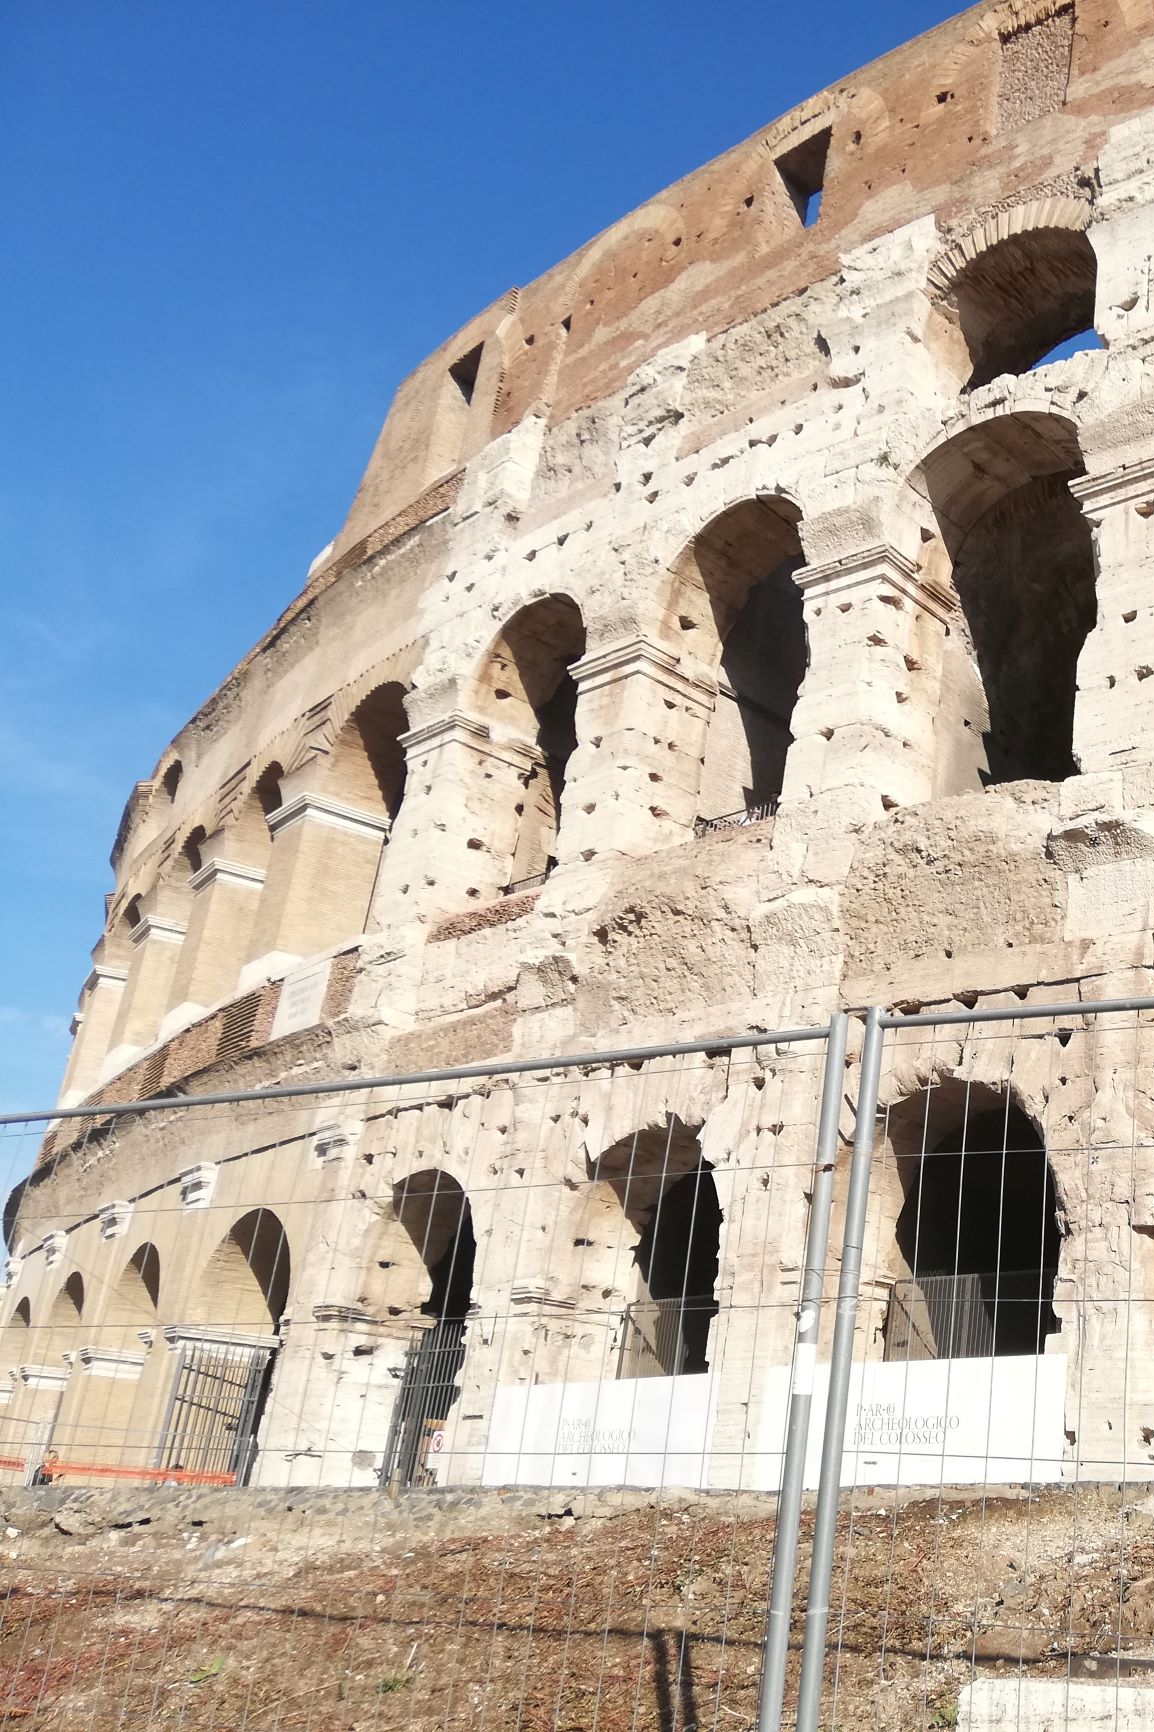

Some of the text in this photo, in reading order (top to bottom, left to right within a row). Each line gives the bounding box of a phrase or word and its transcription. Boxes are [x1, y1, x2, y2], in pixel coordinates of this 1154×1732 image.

[854, 1416, 960, 1431] ARCHEOLOGICO
[558, 1428, 636, 1443] ARCHEOLOGICO
[853, 1431, 946, 1445] DEL COLOSSEO
[577, 1442, 626, 1454] COLOSSEO
